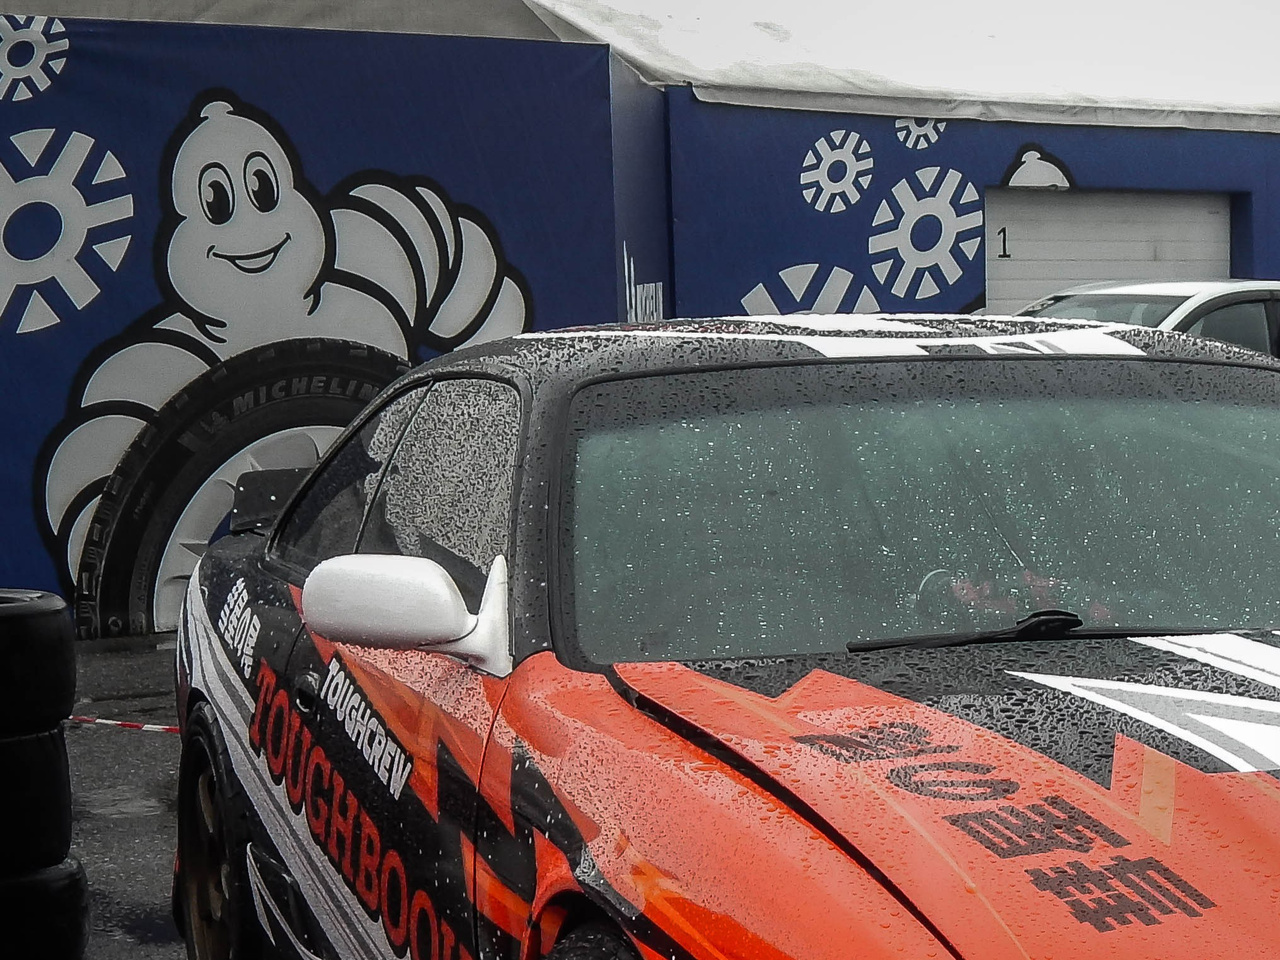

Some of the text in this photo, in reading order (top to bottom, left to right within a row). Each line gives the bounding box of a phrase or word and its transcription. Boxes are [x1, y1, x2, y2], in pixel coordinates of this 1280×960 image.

[997, 226, 1011, 258] 1
[232, 375, 380, 416] MICHELIN
[320, 658, 415, 800] TOUGHCREW
